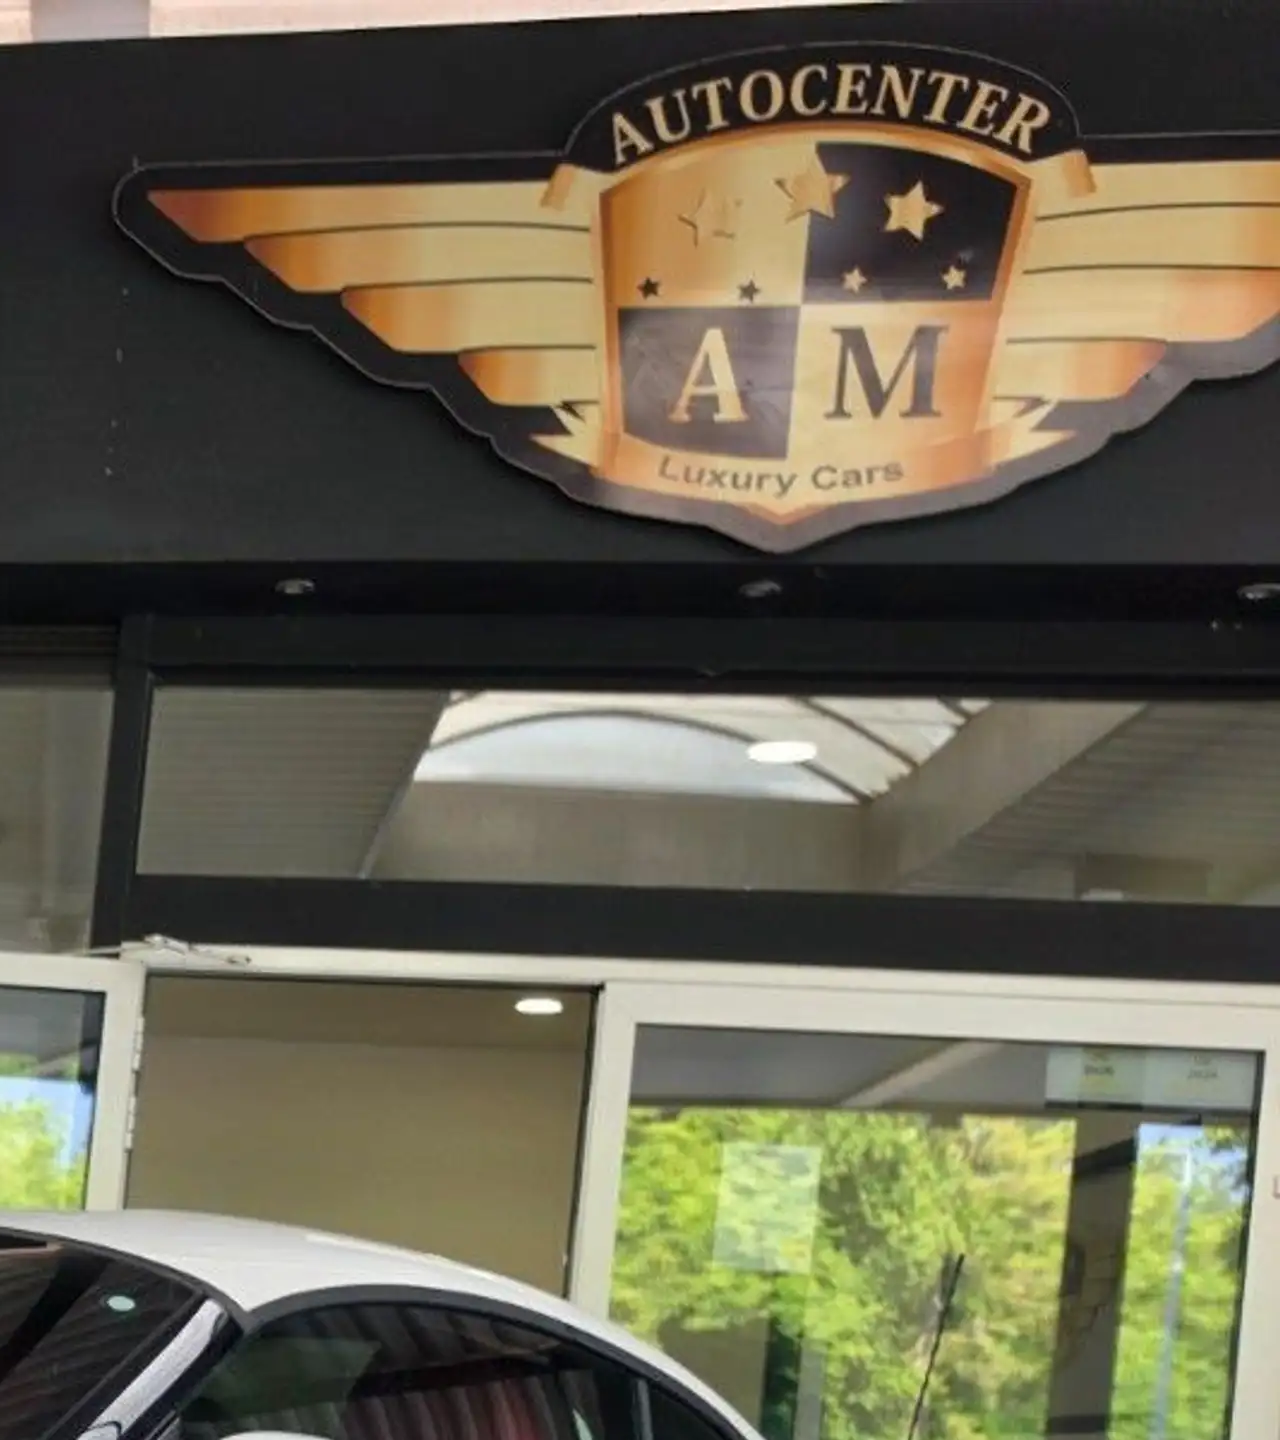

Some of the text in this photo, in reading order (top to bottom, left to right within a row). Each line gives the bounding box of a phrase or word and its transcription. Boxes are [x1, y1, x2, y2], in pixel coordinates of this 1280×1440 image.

[610, 63, 1052, 165] AUTOCENTER
[658, 455, 904, 498] Luxury Cars
